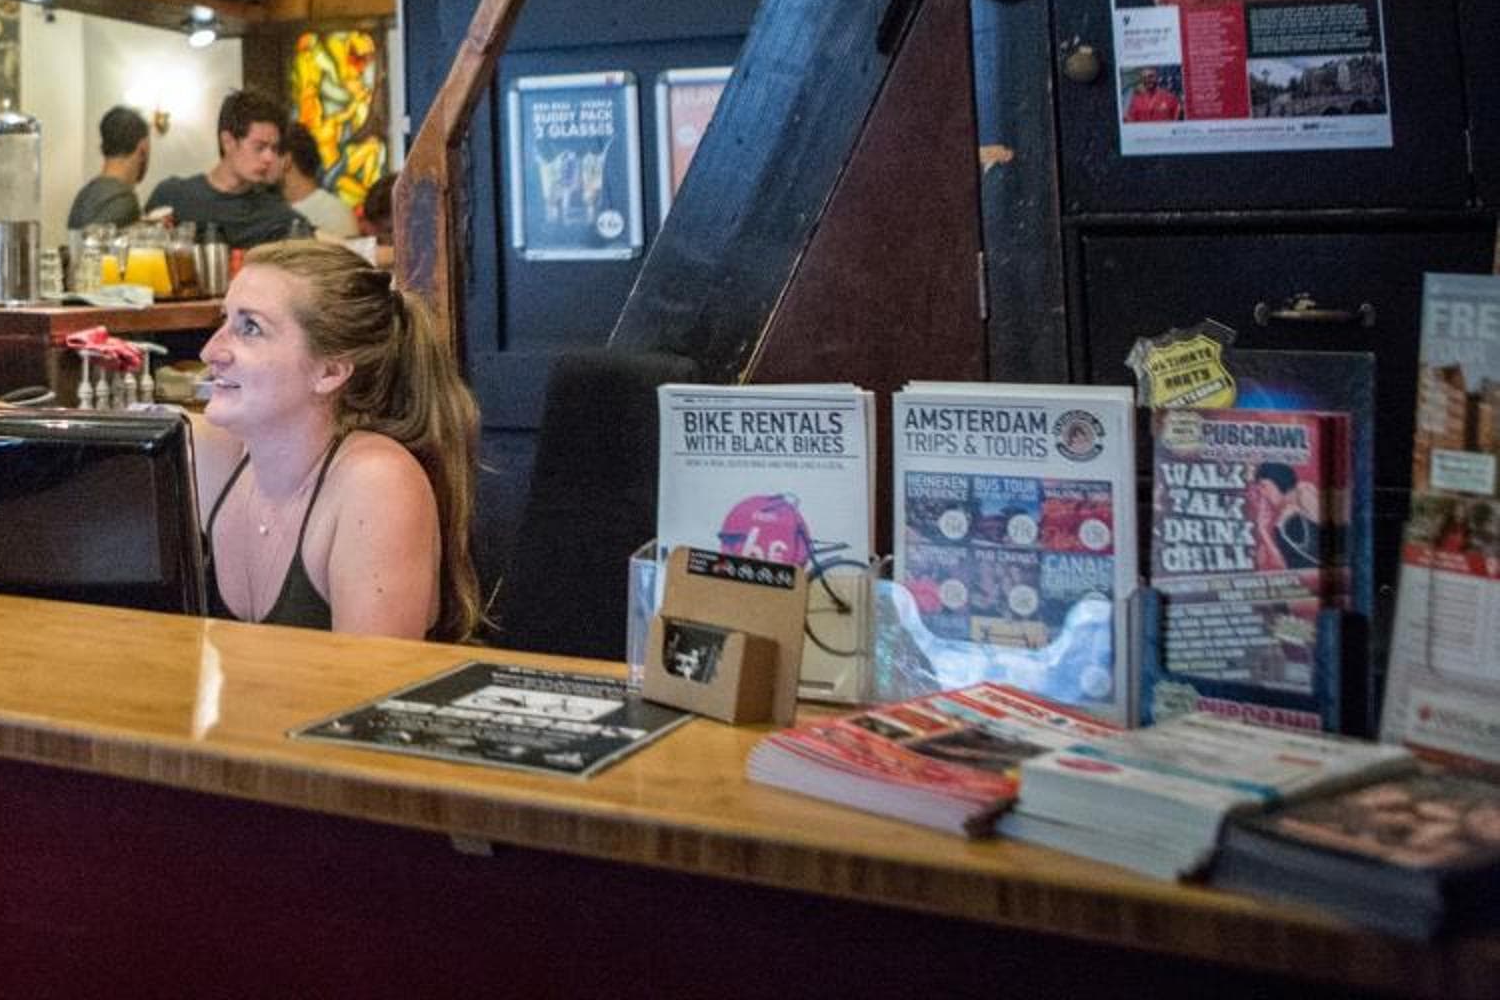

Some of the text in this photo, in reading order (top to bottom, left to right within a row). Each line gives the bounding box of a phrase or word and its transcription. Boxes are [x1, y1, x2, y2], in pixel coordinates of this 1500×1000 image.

[1428, 300, 1500, 340] FRE
[684, 411, 844, 435] BIKE RENTALS
[904, 407, 1048, 434] AMSTERDAM
[685, 435, 845, 454] WITH BLACK BIKES
[904, 431, 1049, 458] TRIPS & TOURS
[1202, 422, 1310, 449] PUBCRAWL
[1161, 462, 1246, 488] WALK
[1168, 488, 1245, 519] TALK
[1163, 518, 1255, 546] DRINK
[1161, 545, 1255, 571] CHILL
